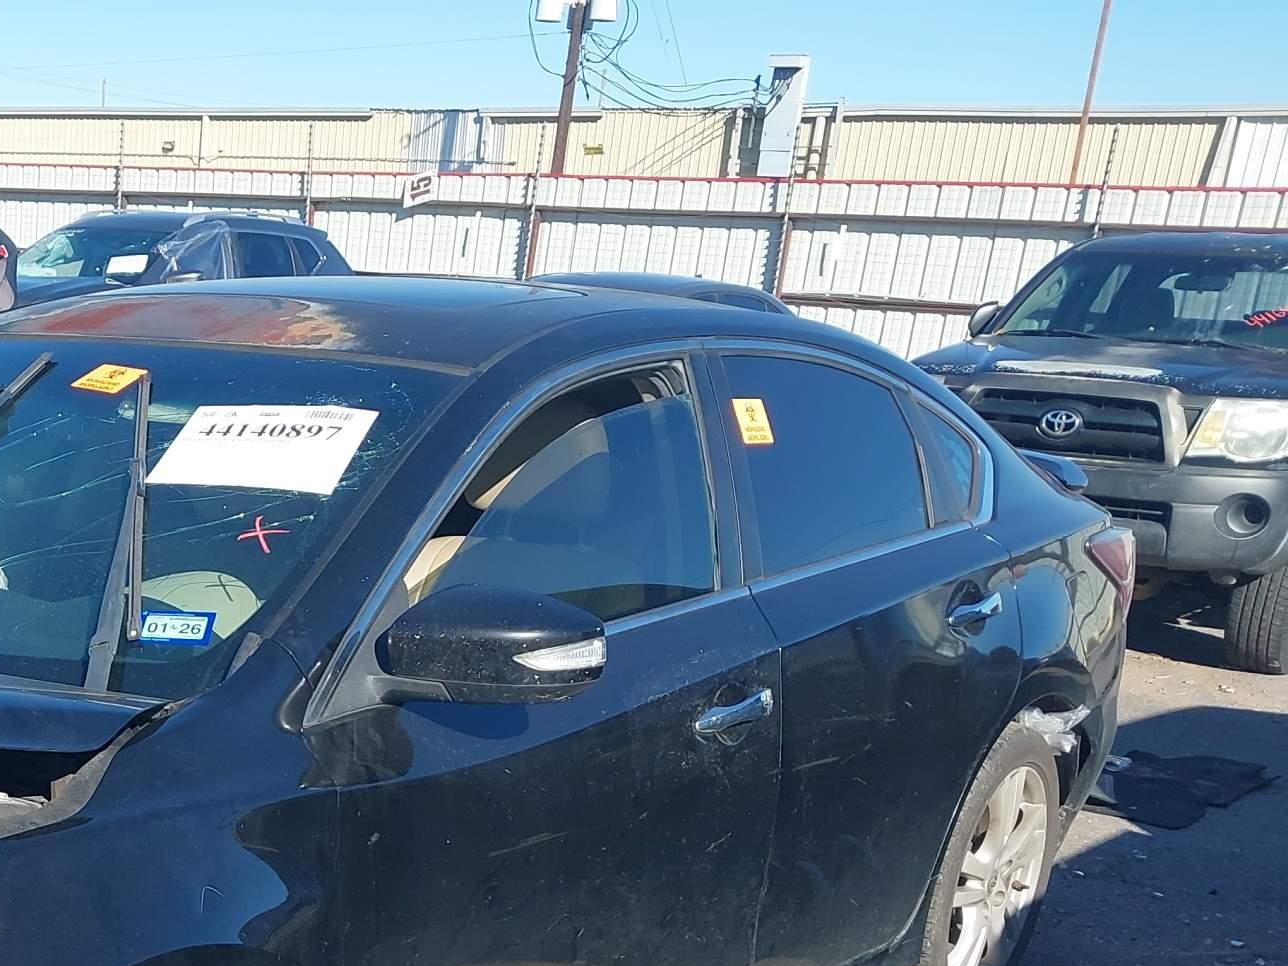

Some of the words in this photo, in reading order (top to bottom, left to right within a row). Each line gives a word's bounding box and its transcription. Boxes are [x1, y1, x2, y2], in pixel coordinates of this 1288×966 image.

[410, 175, 432, 202] 15
[198, 423, 343, 440] 44140897
[179, 623, 202, 635] 26
